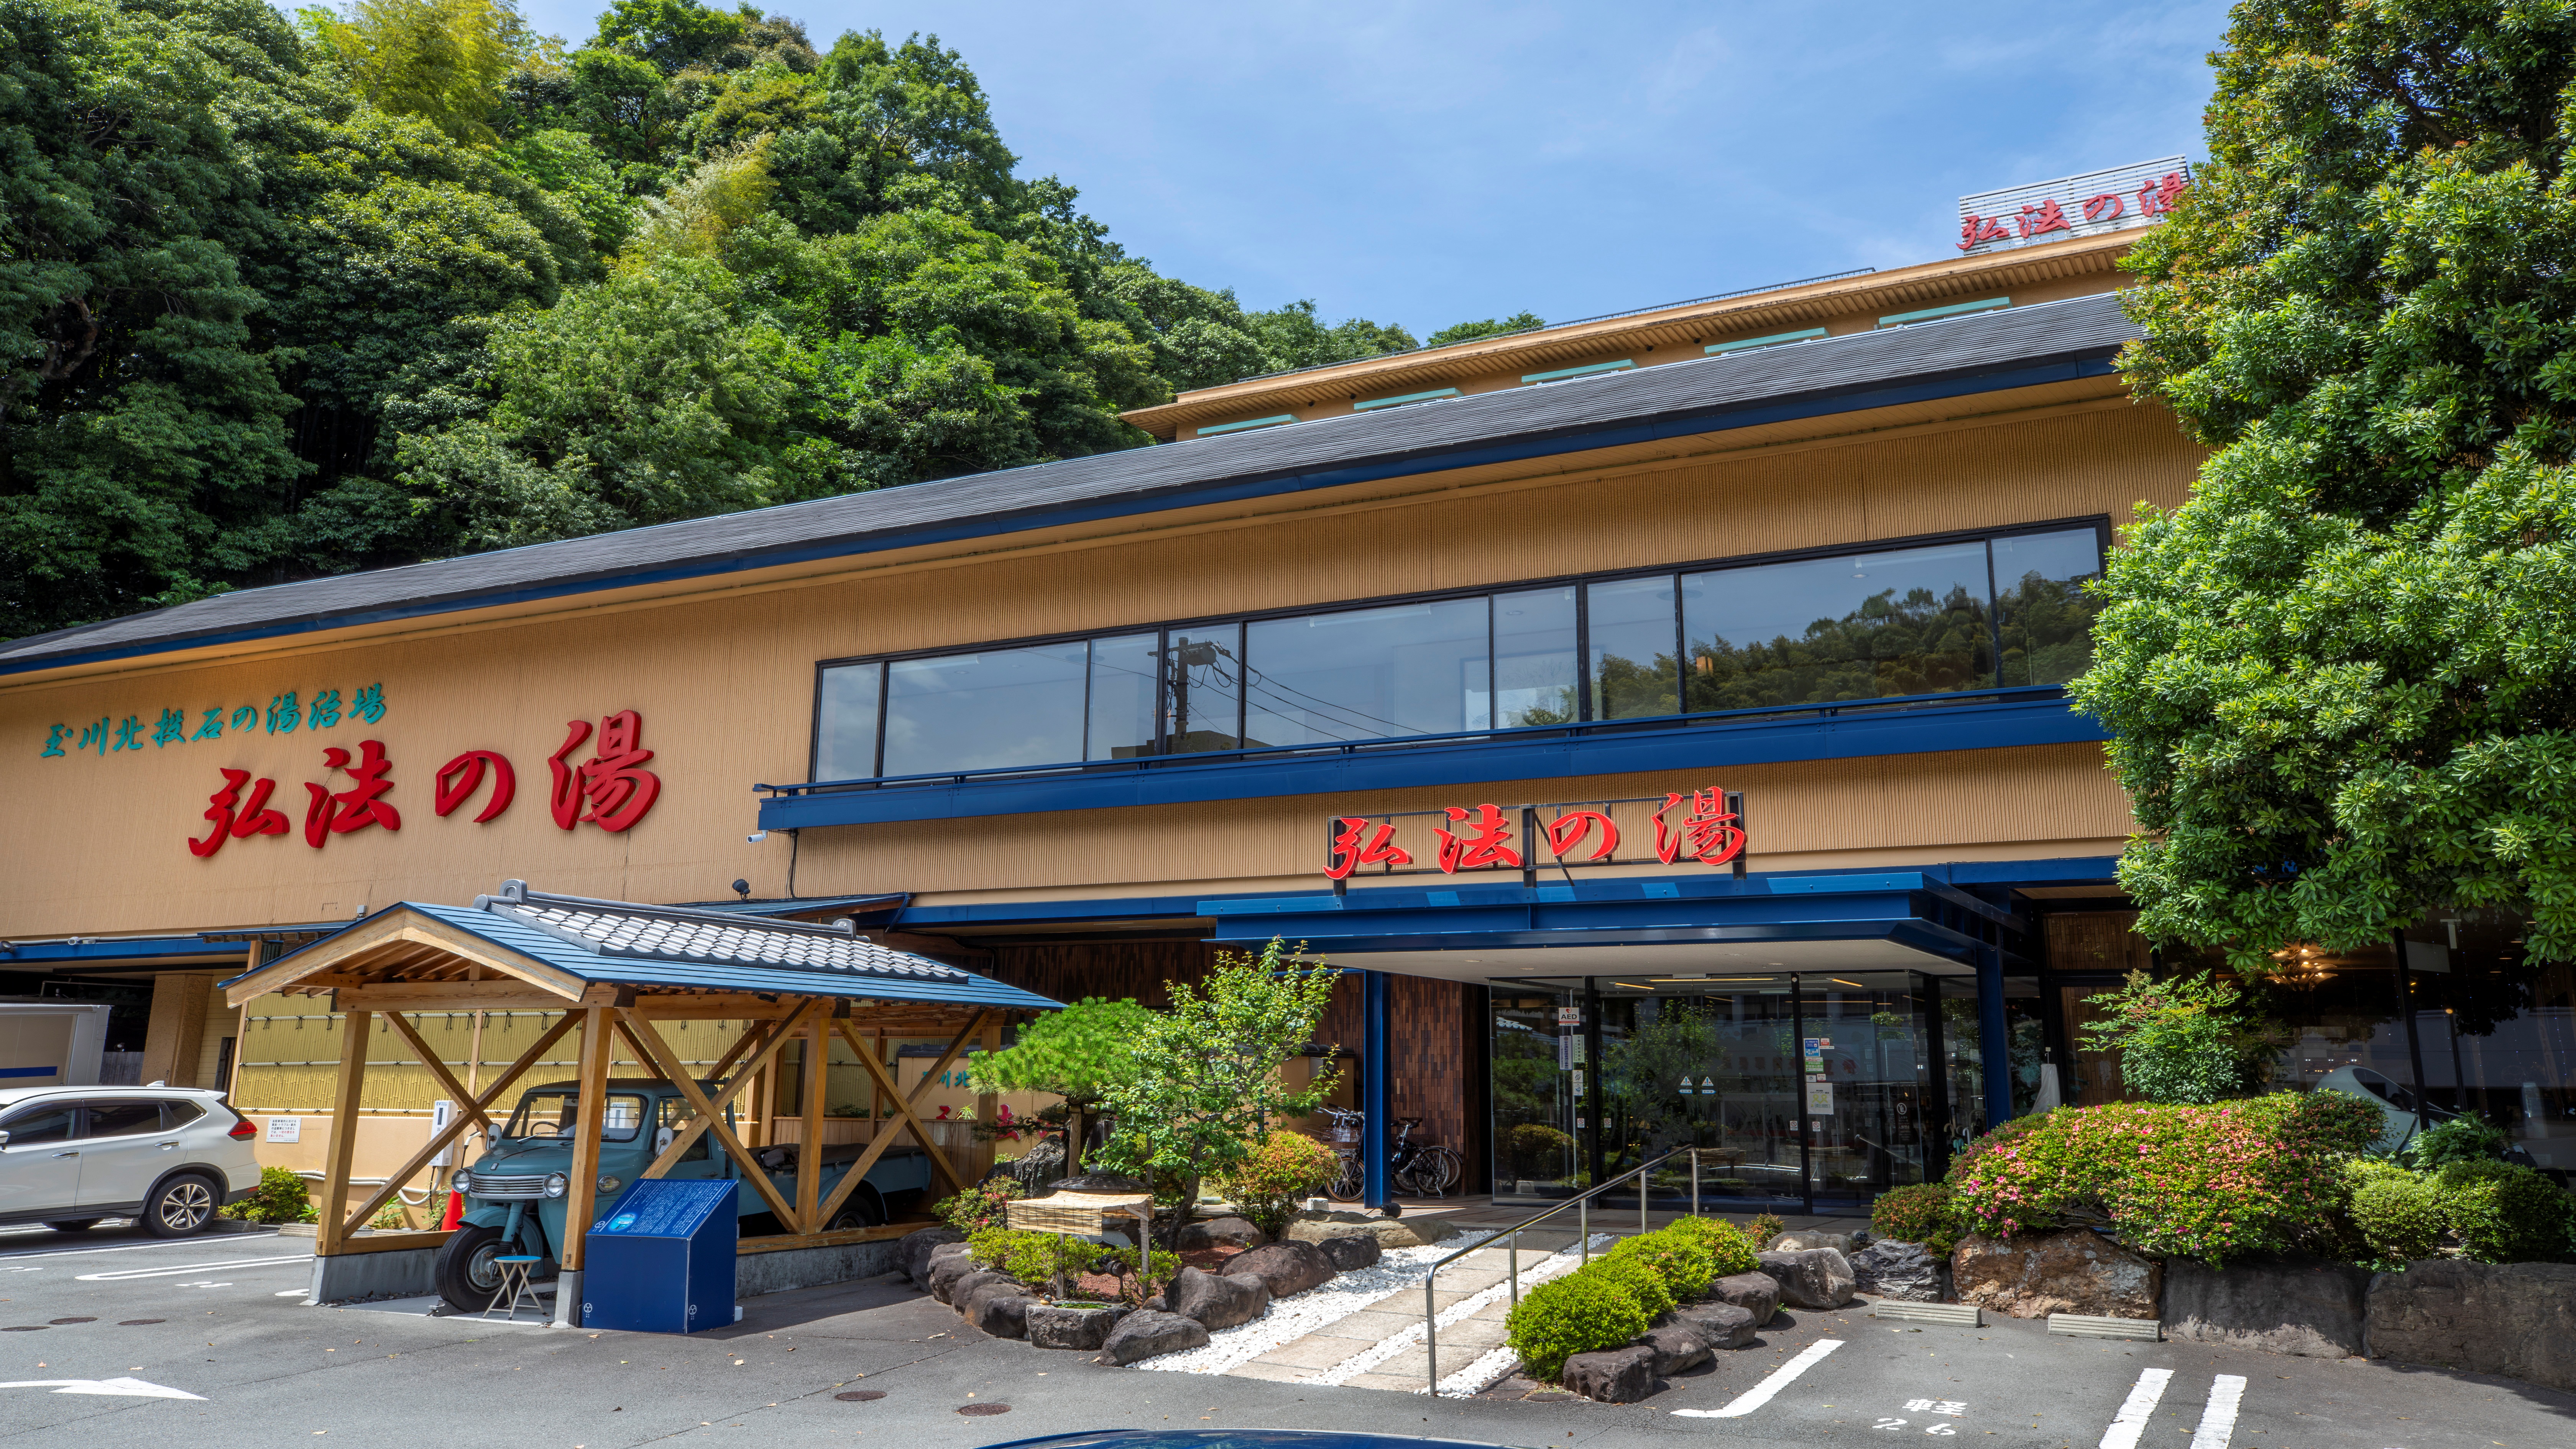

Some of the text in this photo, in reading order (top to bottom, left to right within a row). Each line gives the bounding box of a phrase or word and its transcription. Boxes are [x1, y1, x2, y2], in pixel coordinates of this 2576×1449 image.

[1956, 172, 2189, 250] 弘法の湯
[40, 683, 386, 757] 玉川北投石の湯治場
[188, 708, 660, 858] 弘法の湯
[1323, 786, 1748, 880] 弘法の湯
